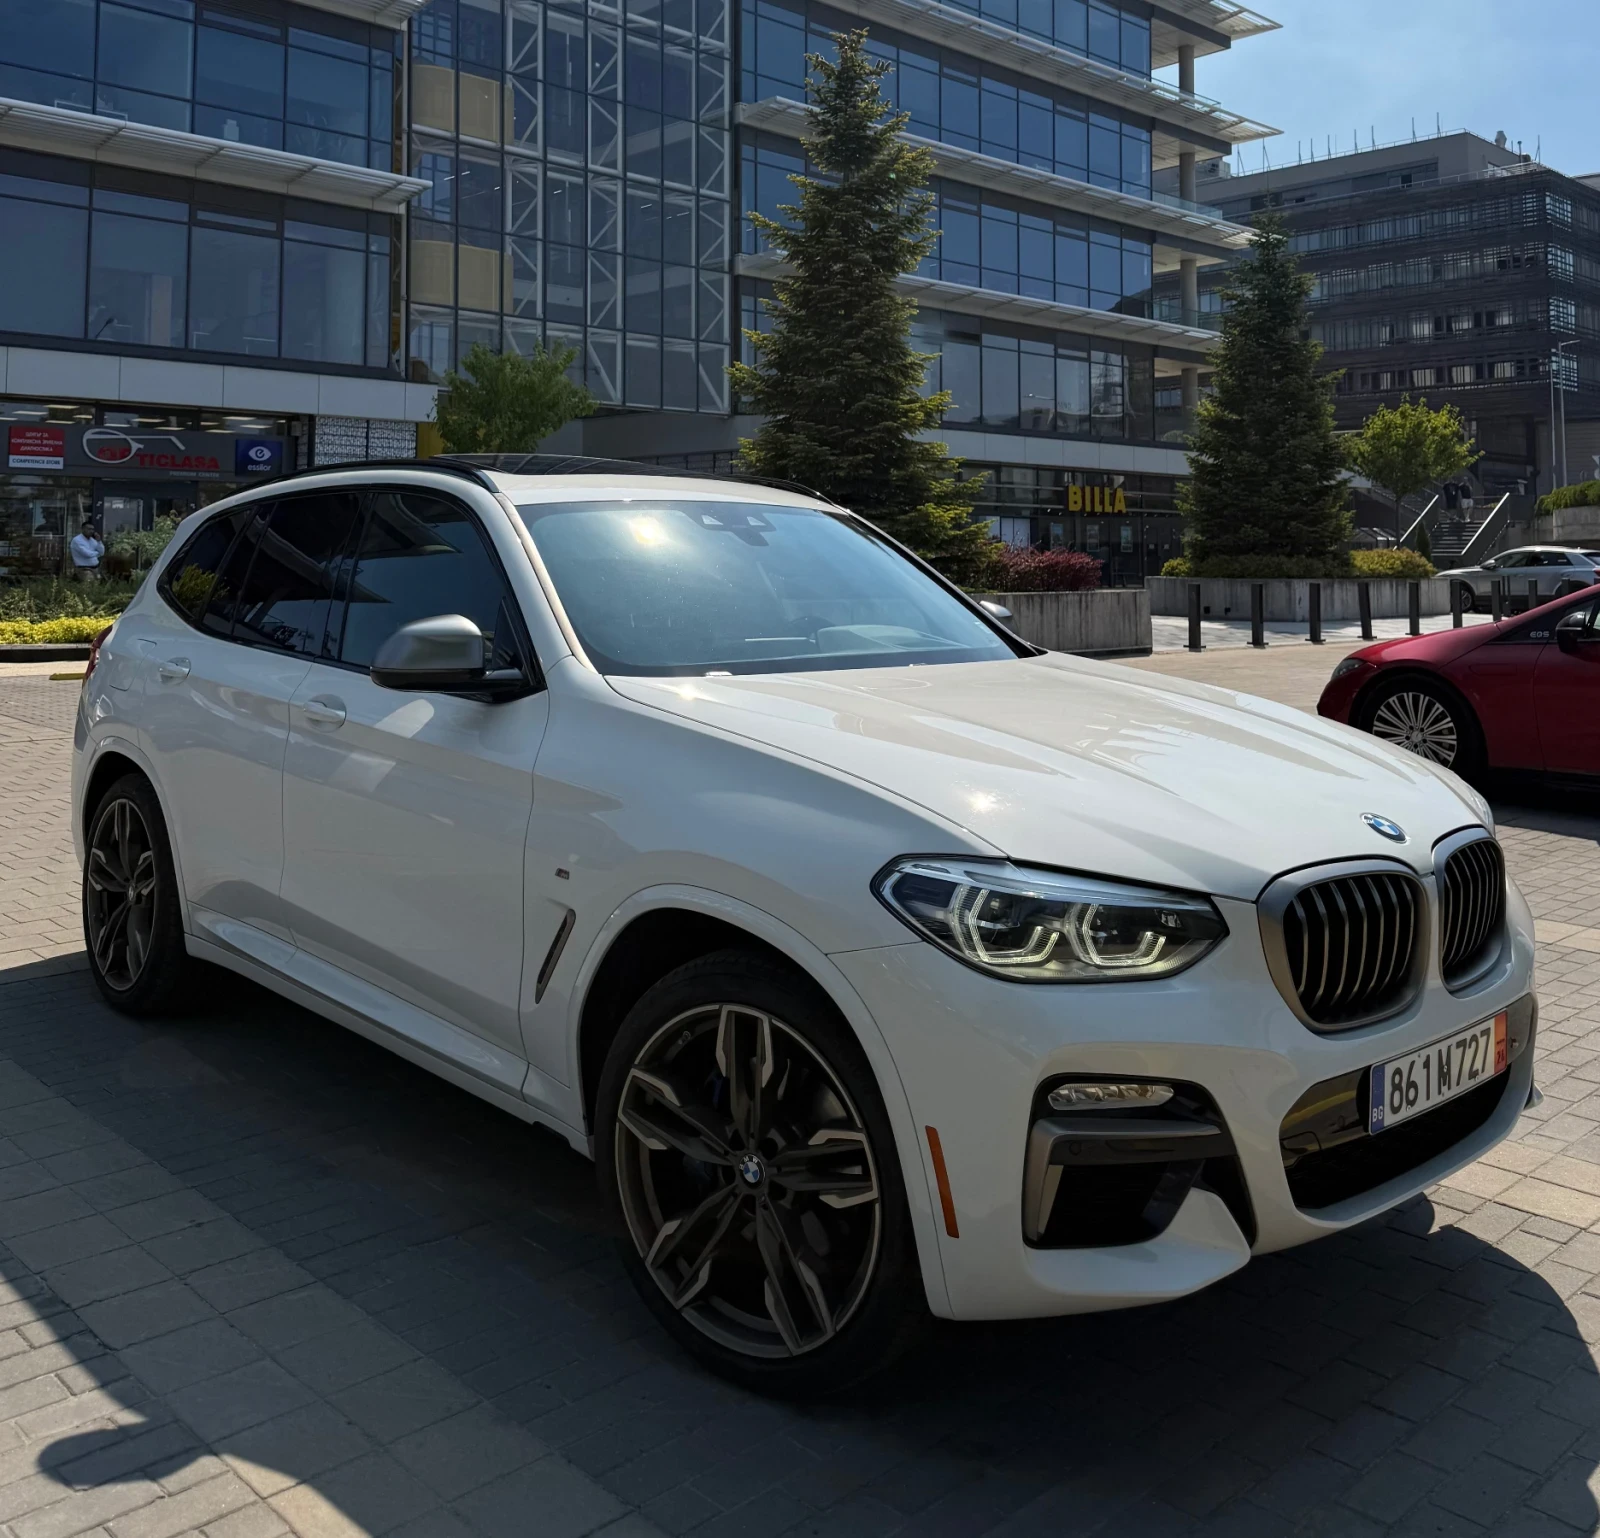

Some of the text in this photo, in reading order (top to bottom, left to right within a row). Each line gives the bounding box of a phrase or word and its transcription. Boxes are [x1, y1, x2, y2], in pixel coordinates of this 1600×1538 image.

[247, 463, 272, 471] essilor
[1068, 485, 1127, 513] BILLA
[1372, 1105, 1384, 1122] BG
[739, 1155, 758, 1170] BMW
